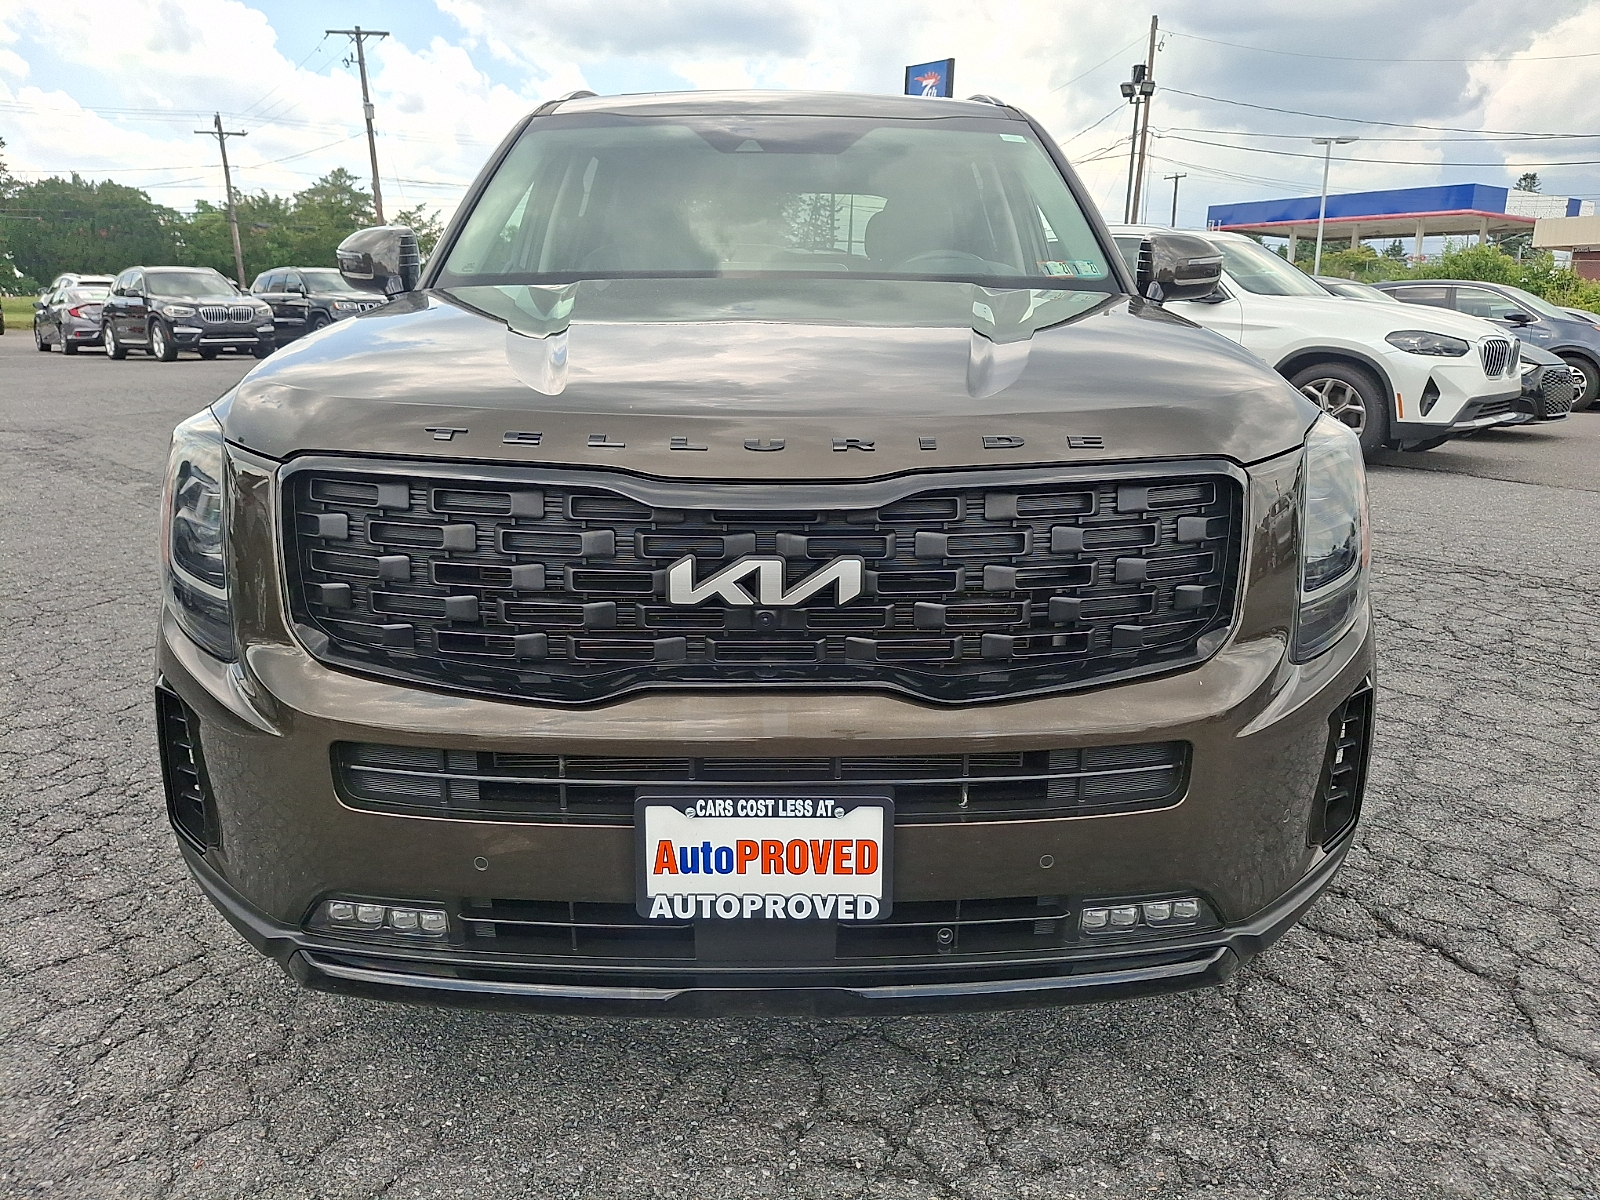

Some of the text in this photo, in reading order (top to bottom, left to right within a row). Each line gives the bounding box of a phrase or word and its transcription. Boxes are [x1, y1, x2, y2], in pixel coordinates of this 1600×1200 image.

[424, 427, 1105, 451] TELLURIDE
[669, 558, 862, 606] KIA
[696, 800, 835, 817] CARS COST LESS AT
[653, 839, 879, 875] AutoPROVED
[649, 895, 880, 920] AUTOPROVED
